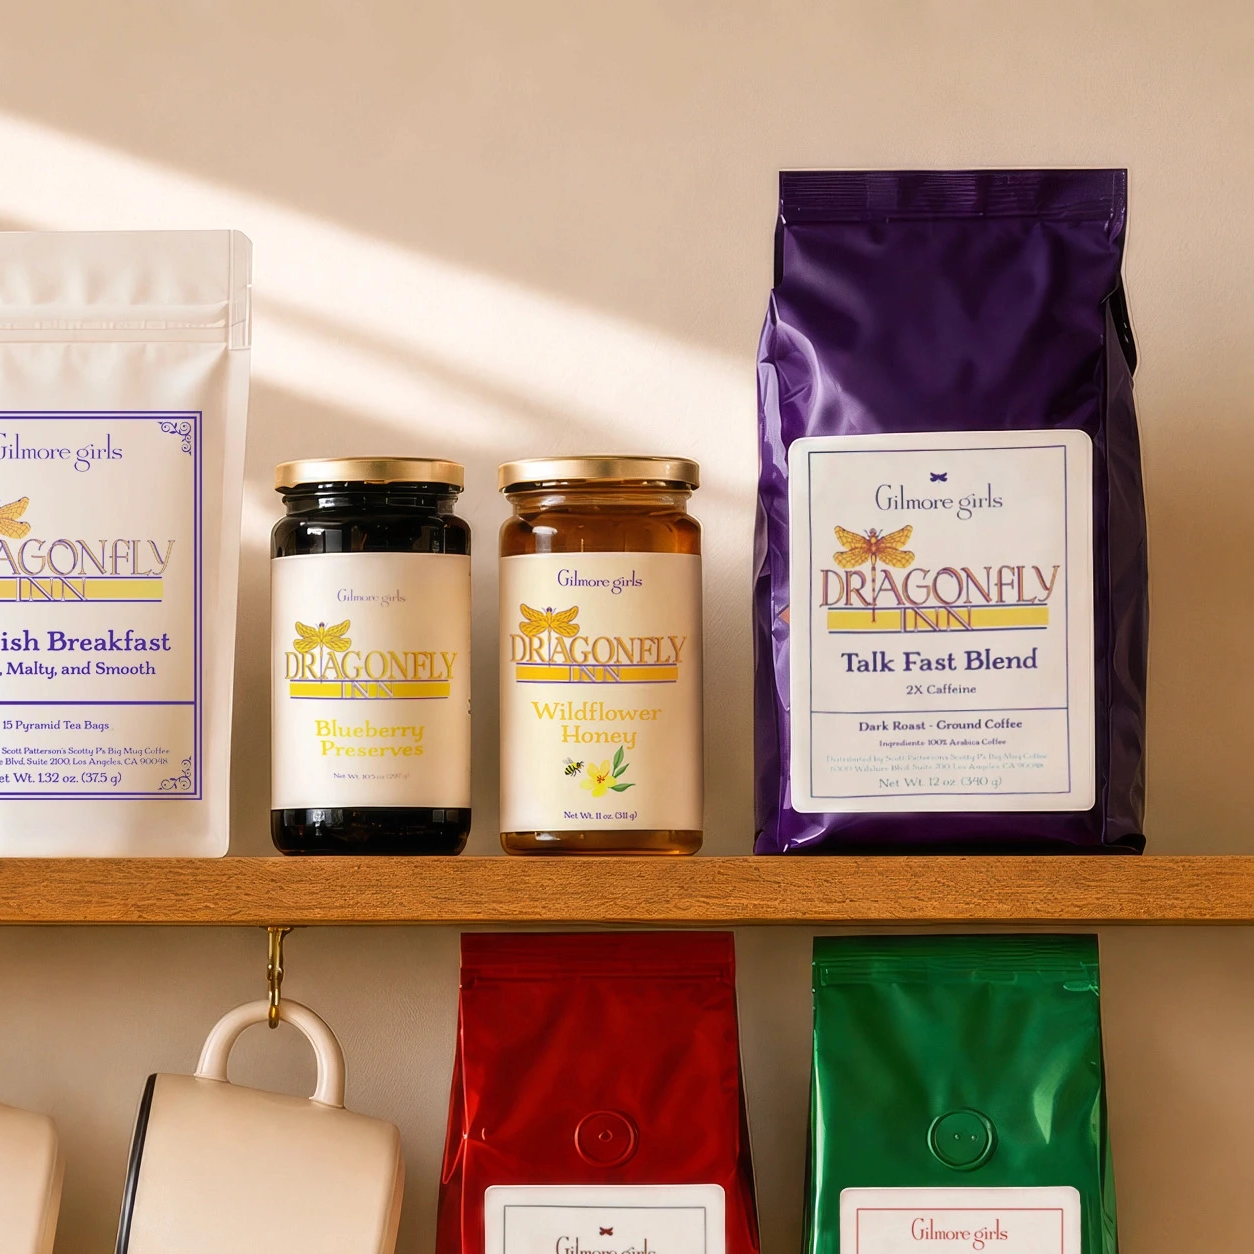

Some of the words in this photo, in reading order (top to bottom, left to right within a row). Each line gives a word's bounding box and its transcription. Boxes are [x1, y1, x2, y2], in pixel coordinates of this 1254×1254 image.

[74, 434, 122, 472] girls
[875, 484, 953, 511] Gilmore
[956, 484, 1003, 520] girls
[15, 577, 87, 601] INN
[558, 569, 610, 587] Gilmore
[611, 570, 642, 595] girls
[820, 565, 1060, 608] DRAGONFLY
[337, 589, 379, 603] Gilmore
[380, 589, 407, 607] girls
[900, 607, 974, 632] INN
[47, 630, 171, 651] Breakfast
[510, 633, 687, 664] DRAGONFLY
[6, 661, 57, 679] Malty,
[62, 661, 90, 674] and
[96, 661, 155, 674] Smooth
[285, 651, 457, 680] DRAGONFLY
[841, 651, 895, 672] Talk
[903, 652, 956, 671] Fast
[964, 648, 1037, 670] Blend
[568, 665, 621, 682] INN
[340, 681, 394, 698] INN
[907, 685, 923, 694] 2X
[927, 684, 976, 694] Caffeine
[532, 701, 661, 720] Wildflower
[3, 721, 12, 729] 15
[16, 720, 60, 732] Pyramid
[63, 721, 81, 729] Tea
[84, 721, 109, 732] Bags
[315, 719, 425, 741] Blueberry
[859, 721, 888, 731] Dark
[893, 721, 925, 730] Roast
[937, 719, 981, 729] Ground
[985, 719, 1022, 728] Coffee
[320, 739, 424, 756] Preserves
[562, 725, 636, 750] Honey
[564, 811, 578, 819] Net
[630, 812, 637, 820] g)
[912, 1218, 970, 1240] Gilmore
[973, 1219, 1008, 1250] girls
